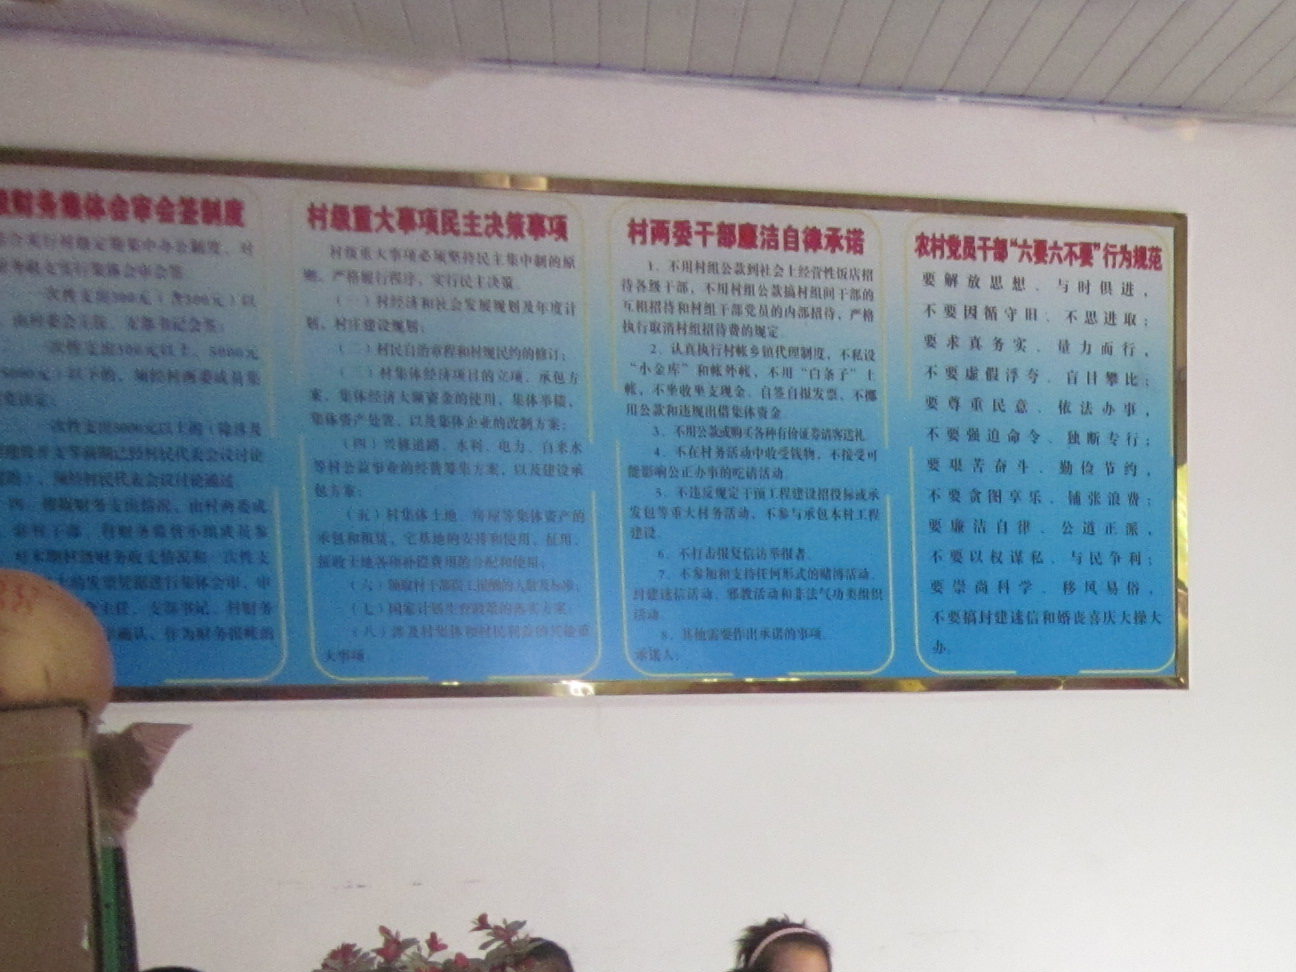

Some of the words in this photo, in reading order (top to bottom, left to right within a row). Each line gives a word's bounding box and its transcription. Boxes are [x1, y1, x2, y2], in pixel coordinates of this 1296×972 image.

[307, 202, 568, 241] 村级重大事项民主决策事项
[626, 216, 866, 256] 村两委干部廉洁自律承诺
[931, 610, 1163, 627] 不要搞封建迷信和婚丧喜庆大操大
